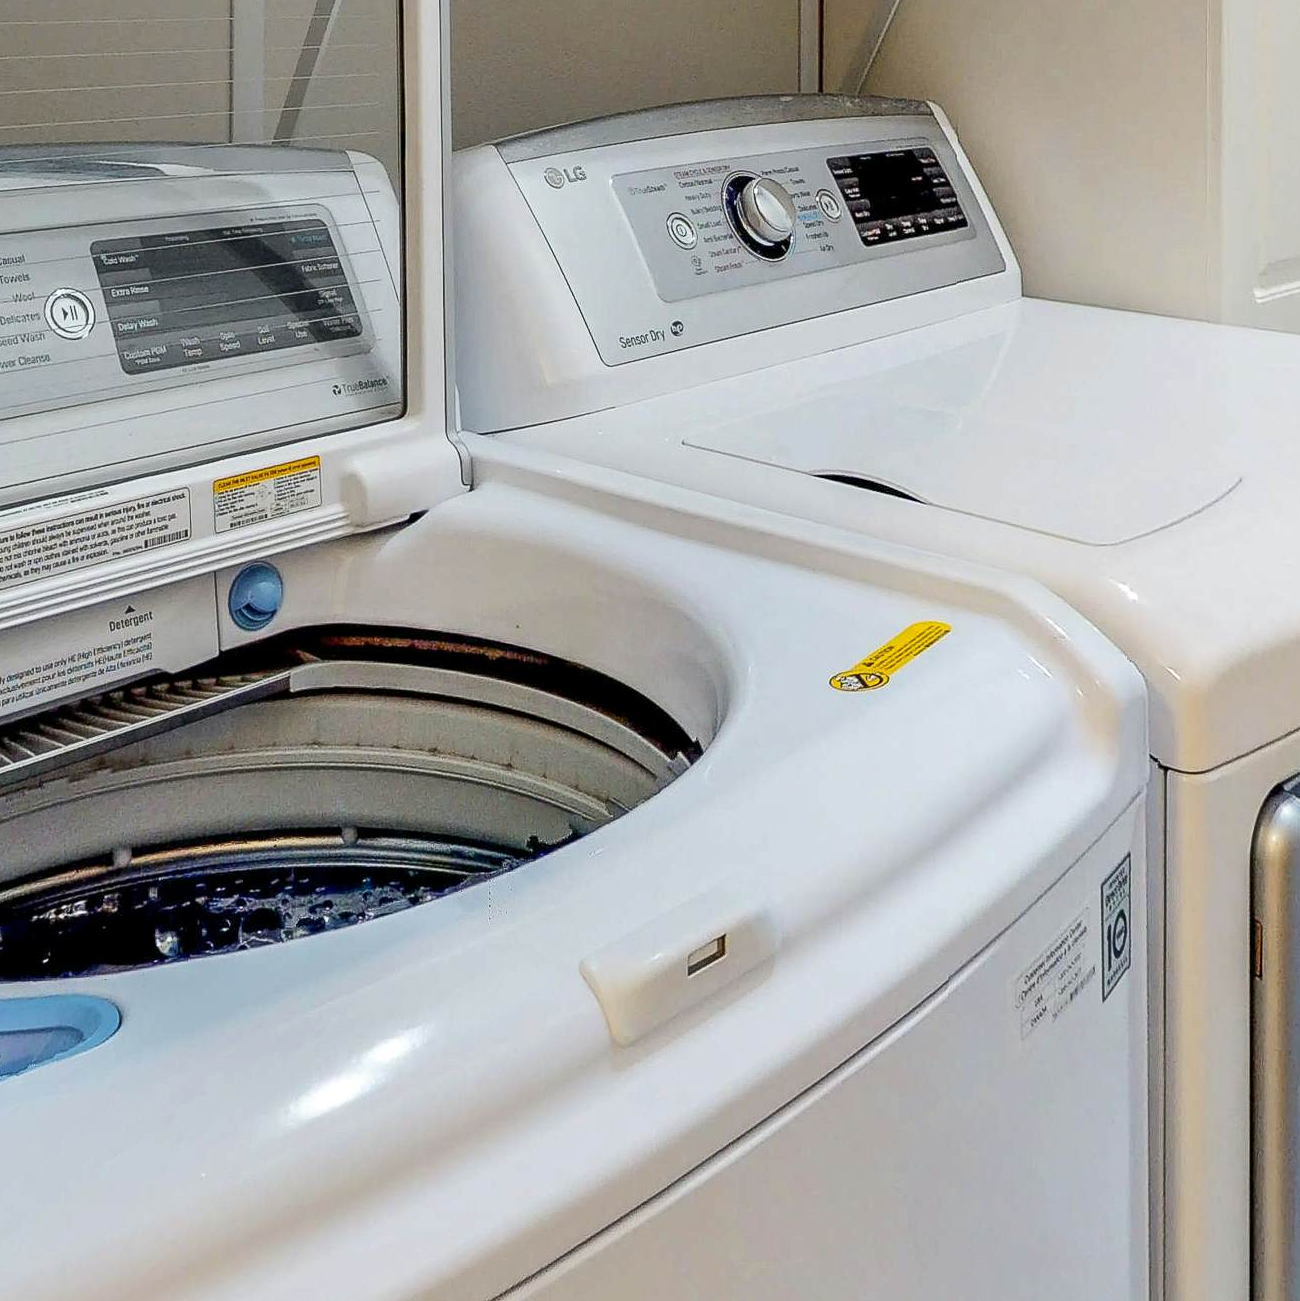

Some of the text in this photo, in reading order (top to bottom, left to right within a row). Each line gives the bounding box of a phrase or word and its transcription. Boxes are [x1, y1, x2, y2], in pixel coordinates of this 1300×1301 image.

[562, 166, 587, 183] LG
[111, 287, 130, 297] Extra
[0, 312, 41, 326] Delicates
[19, 332, 45, 343] Wash
[619, 330, 665, 349] Sensor Dry
[19, 354, 51, 366] Cleanse
[109, 612, 153, 632] Detergent
